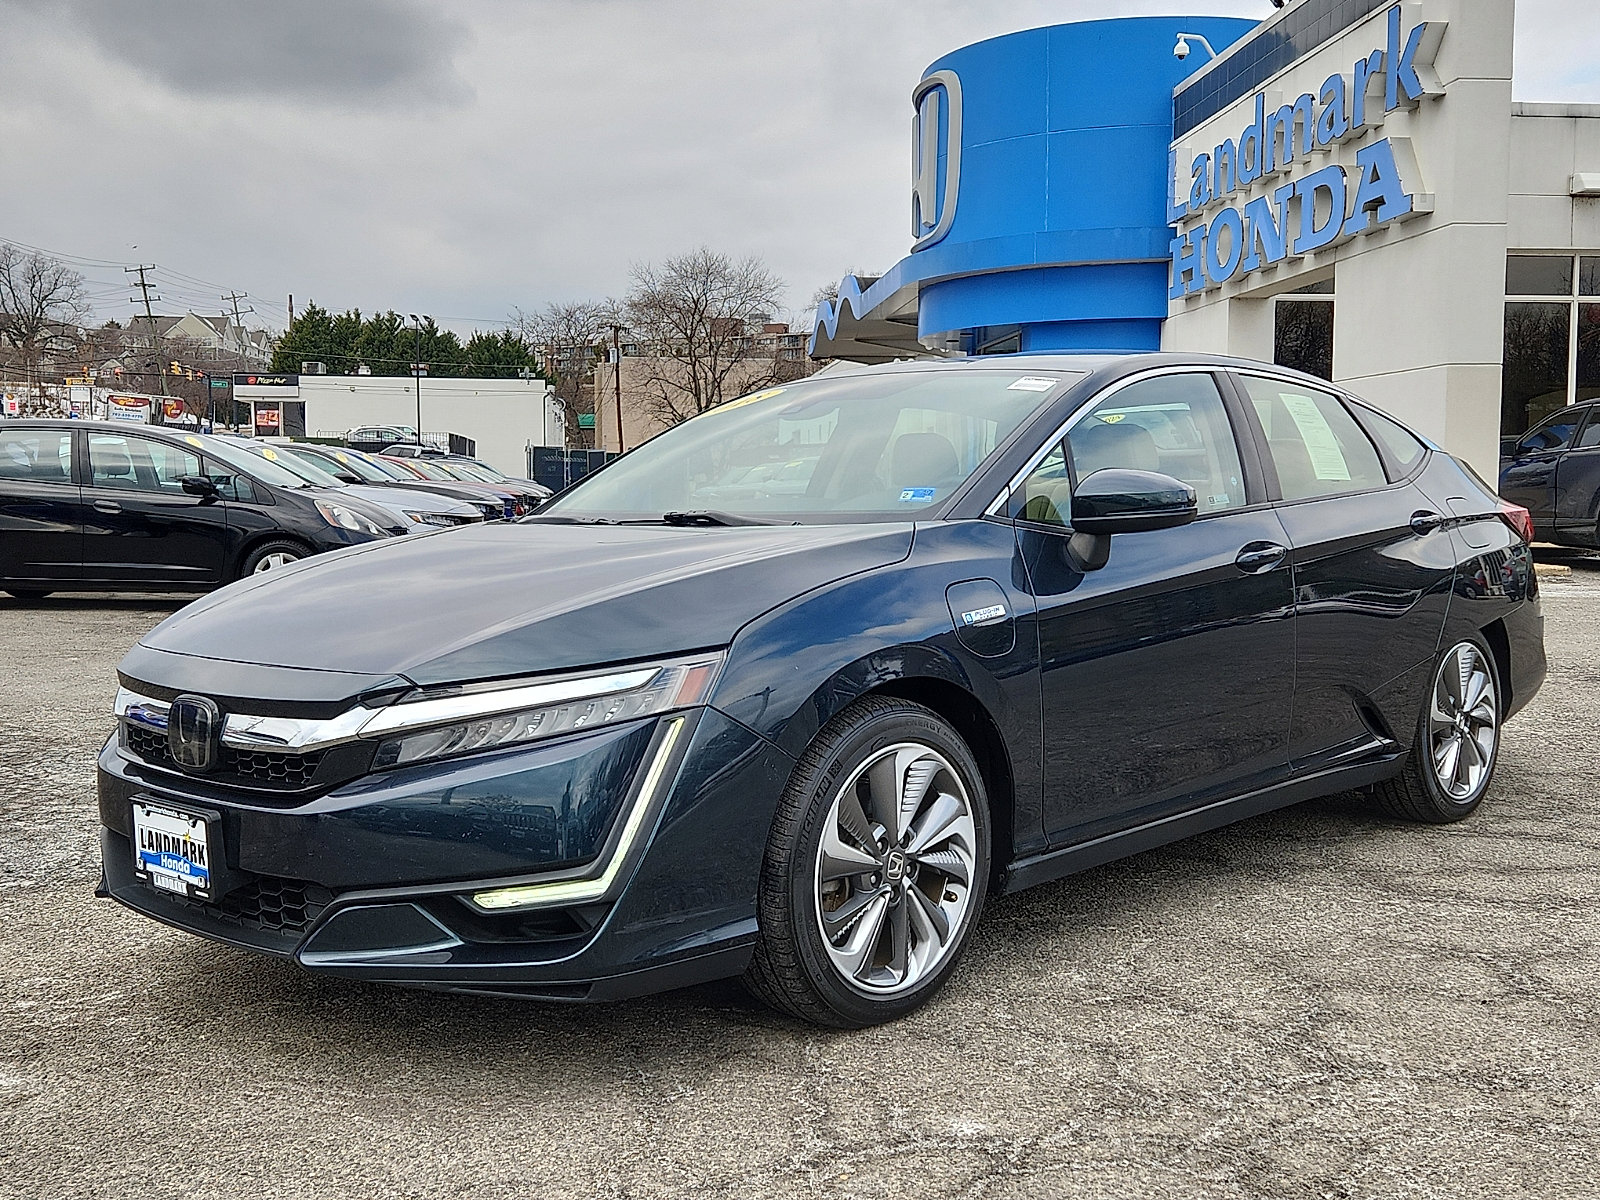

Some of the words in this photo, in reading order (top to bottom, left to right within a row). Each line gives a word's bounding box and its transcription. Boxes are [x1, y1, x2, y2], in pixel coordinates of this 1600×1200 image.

[1167, 5, 1426, 225] Landmark
[1169, 138, 1413, 300] HONDA
[256, 376, 274, 384] Pizza
[974, 606, 1000, 617] PLUG-IN
[140, 827, 206, 867] LANDMARK
[161, 854, 190, 874] Honda
